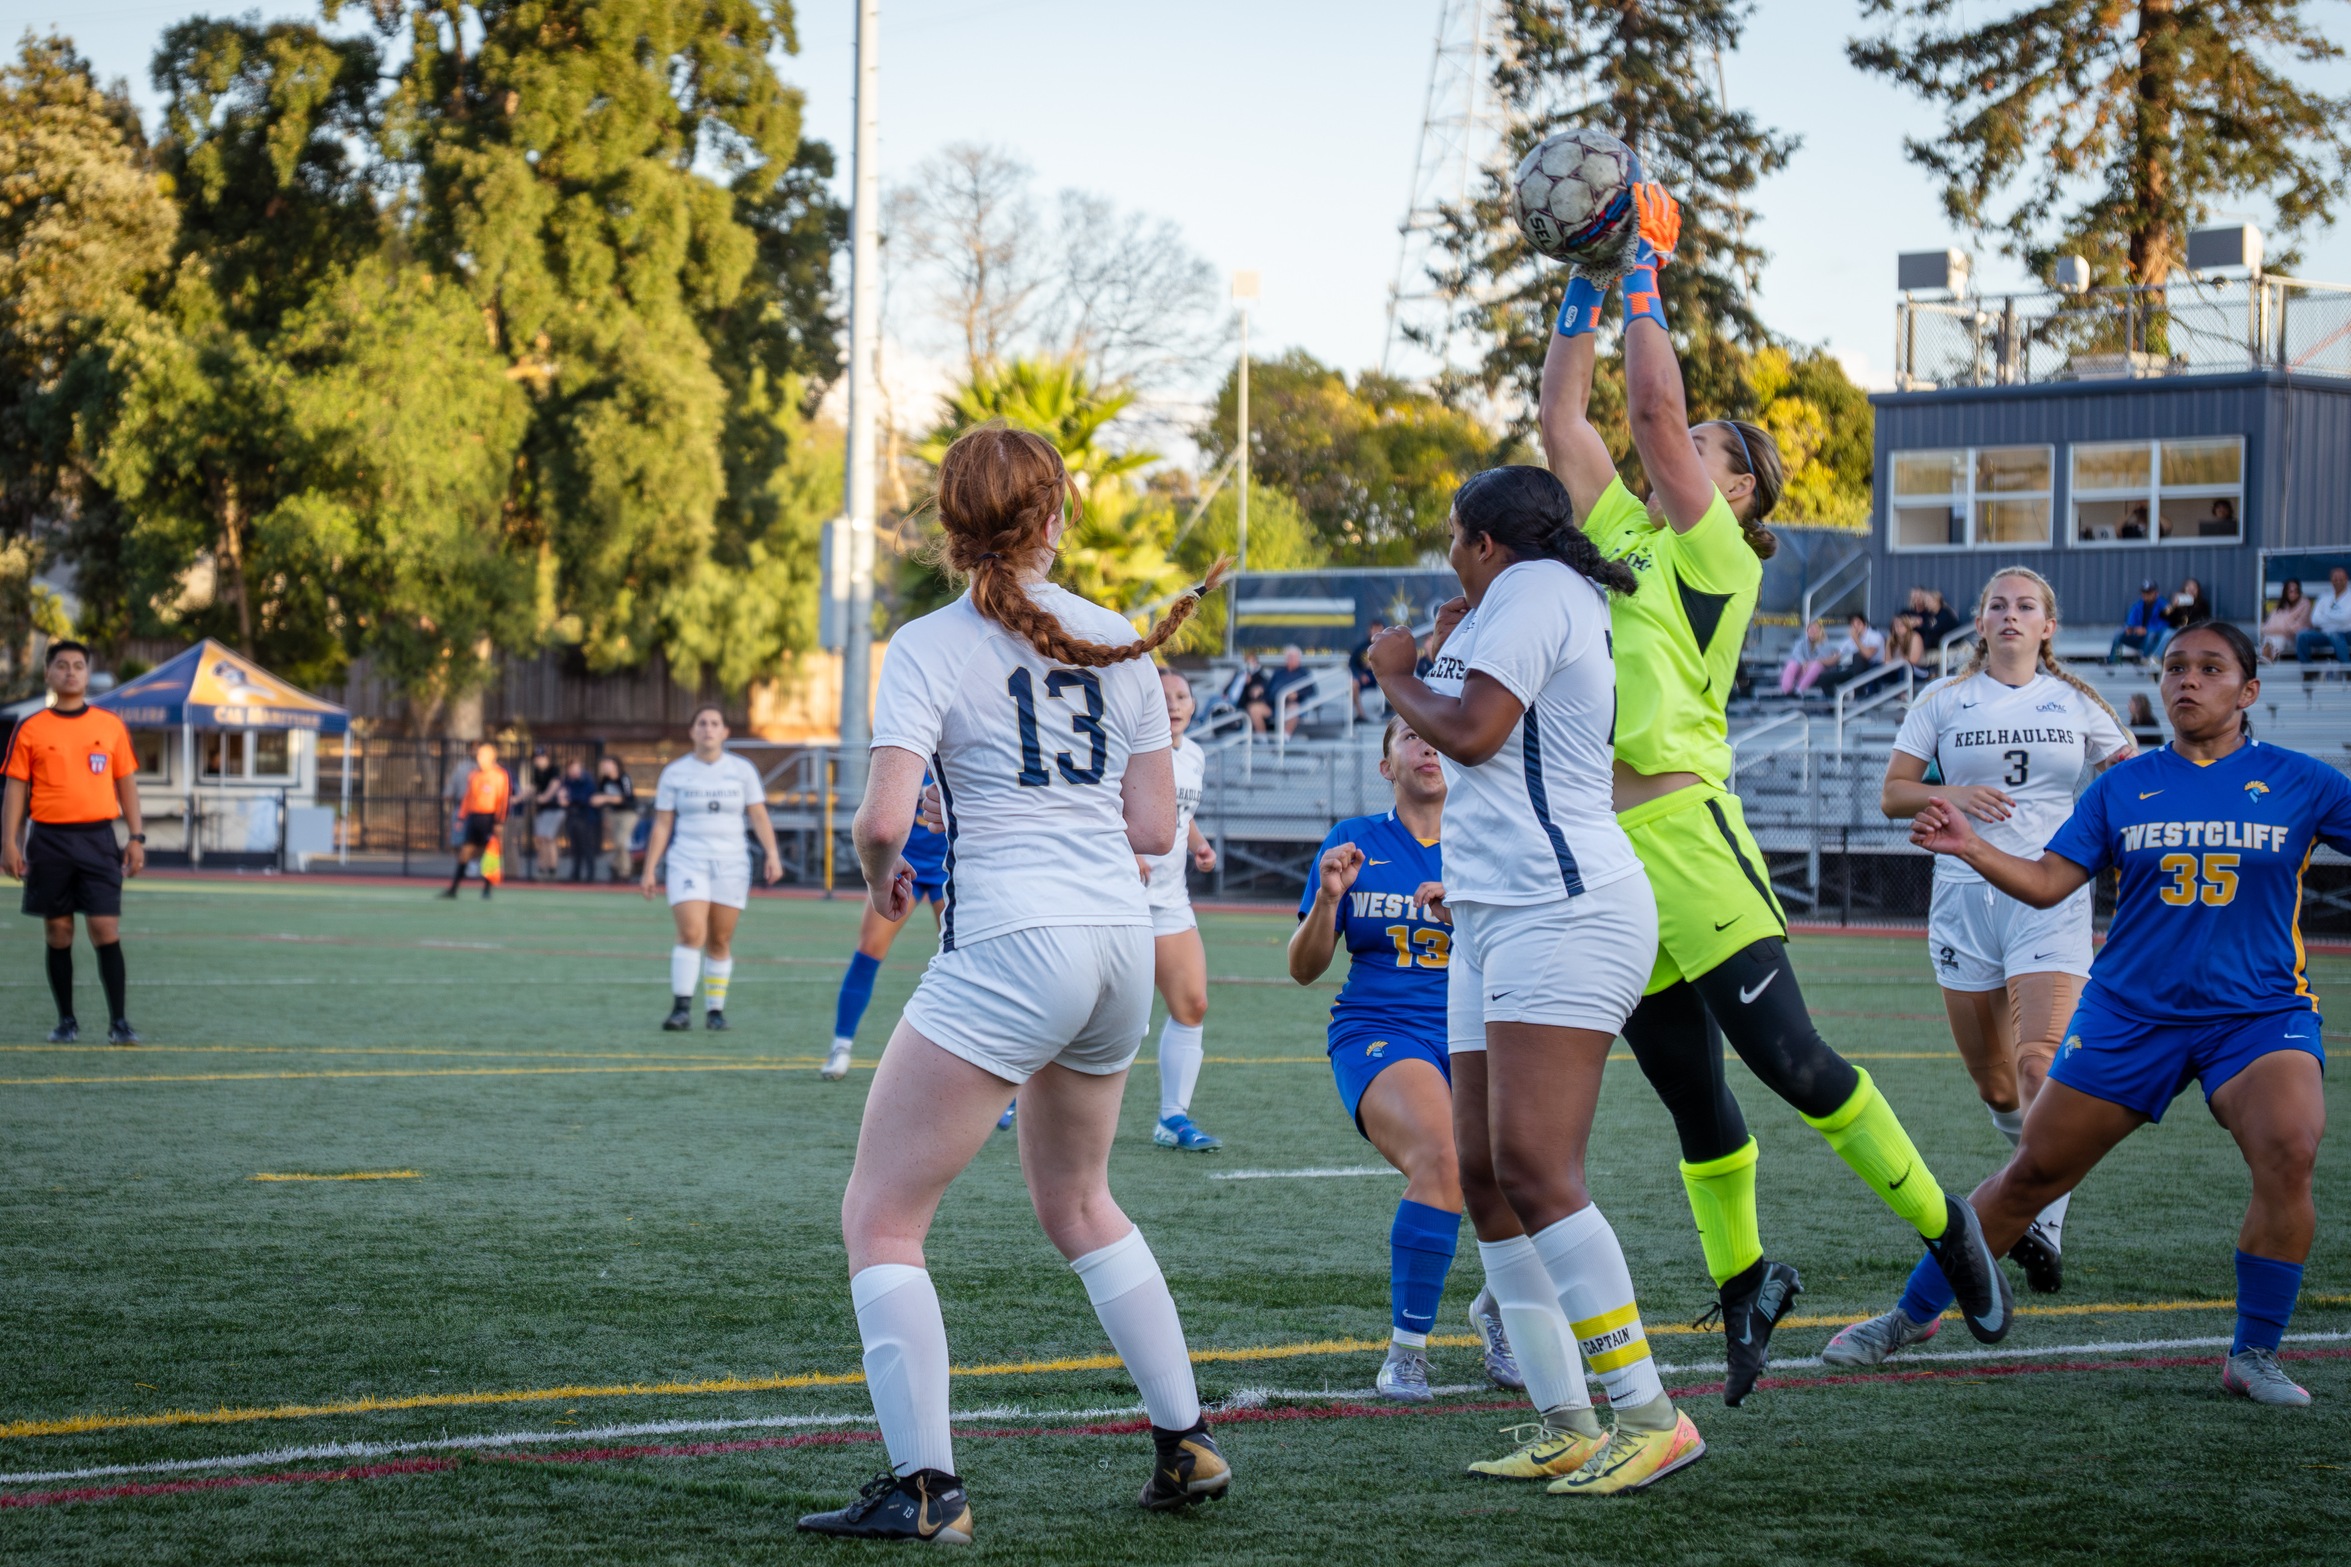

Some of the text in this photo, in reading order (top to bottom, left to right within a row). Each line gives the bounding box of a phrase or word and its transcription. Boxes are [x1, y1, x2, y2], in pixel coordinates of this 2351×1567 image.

[1006, 665, 1108, 789] 13
[1955, 728, 2074, 748] KEELHAULERS
[2004, 750, 2029, 787] 3
[2120, 821, 2289, 852] WESTCLIFF
[2160, 853, 2241, 907] 35
[1386, 925, 1450, 968] 13
[1583, 1327, 1630, 1355] CAPTAIN
[903, 1506, 914, 1519] 13
